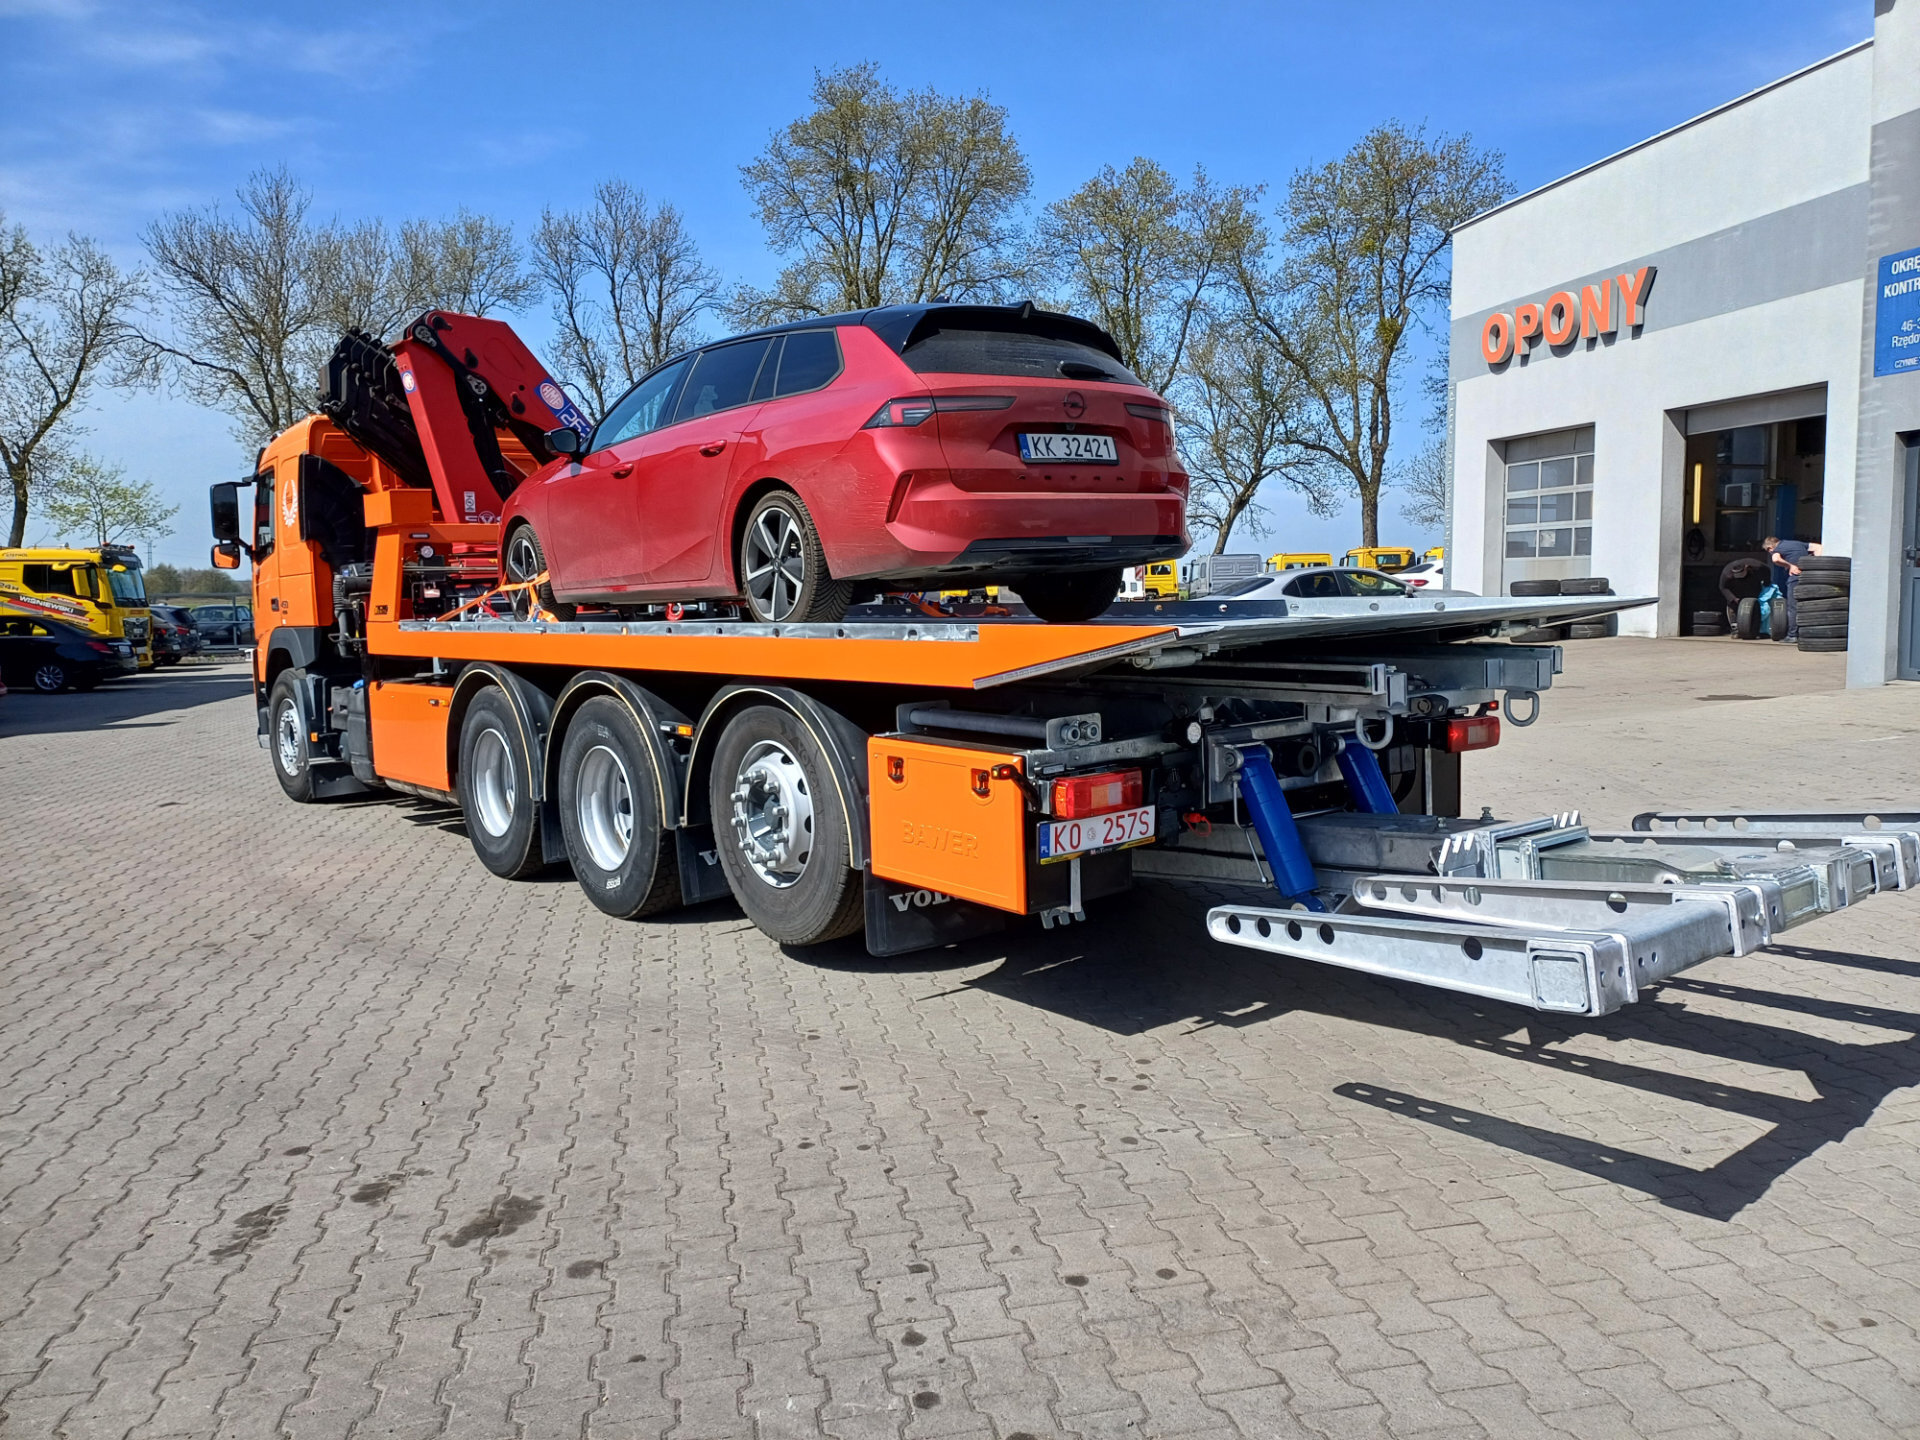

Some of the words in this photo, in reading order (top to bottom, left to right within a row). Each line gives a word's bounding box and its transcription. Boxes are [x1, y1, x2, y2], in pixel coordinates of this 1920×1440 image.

[1883, 277, 1920, 298] KONTR
[1481, 266, 1657, 364] OPONY
[1891, 333, 1920, 349] Rzędo
[1032, 436, 1057, 456] KK
[1061, 437, 1111, 458] 32421
[1102, 810, 1150, 845] 257S
[900, 819, 980, 860] BAWER
[888, 889, 959, 912] VOL
